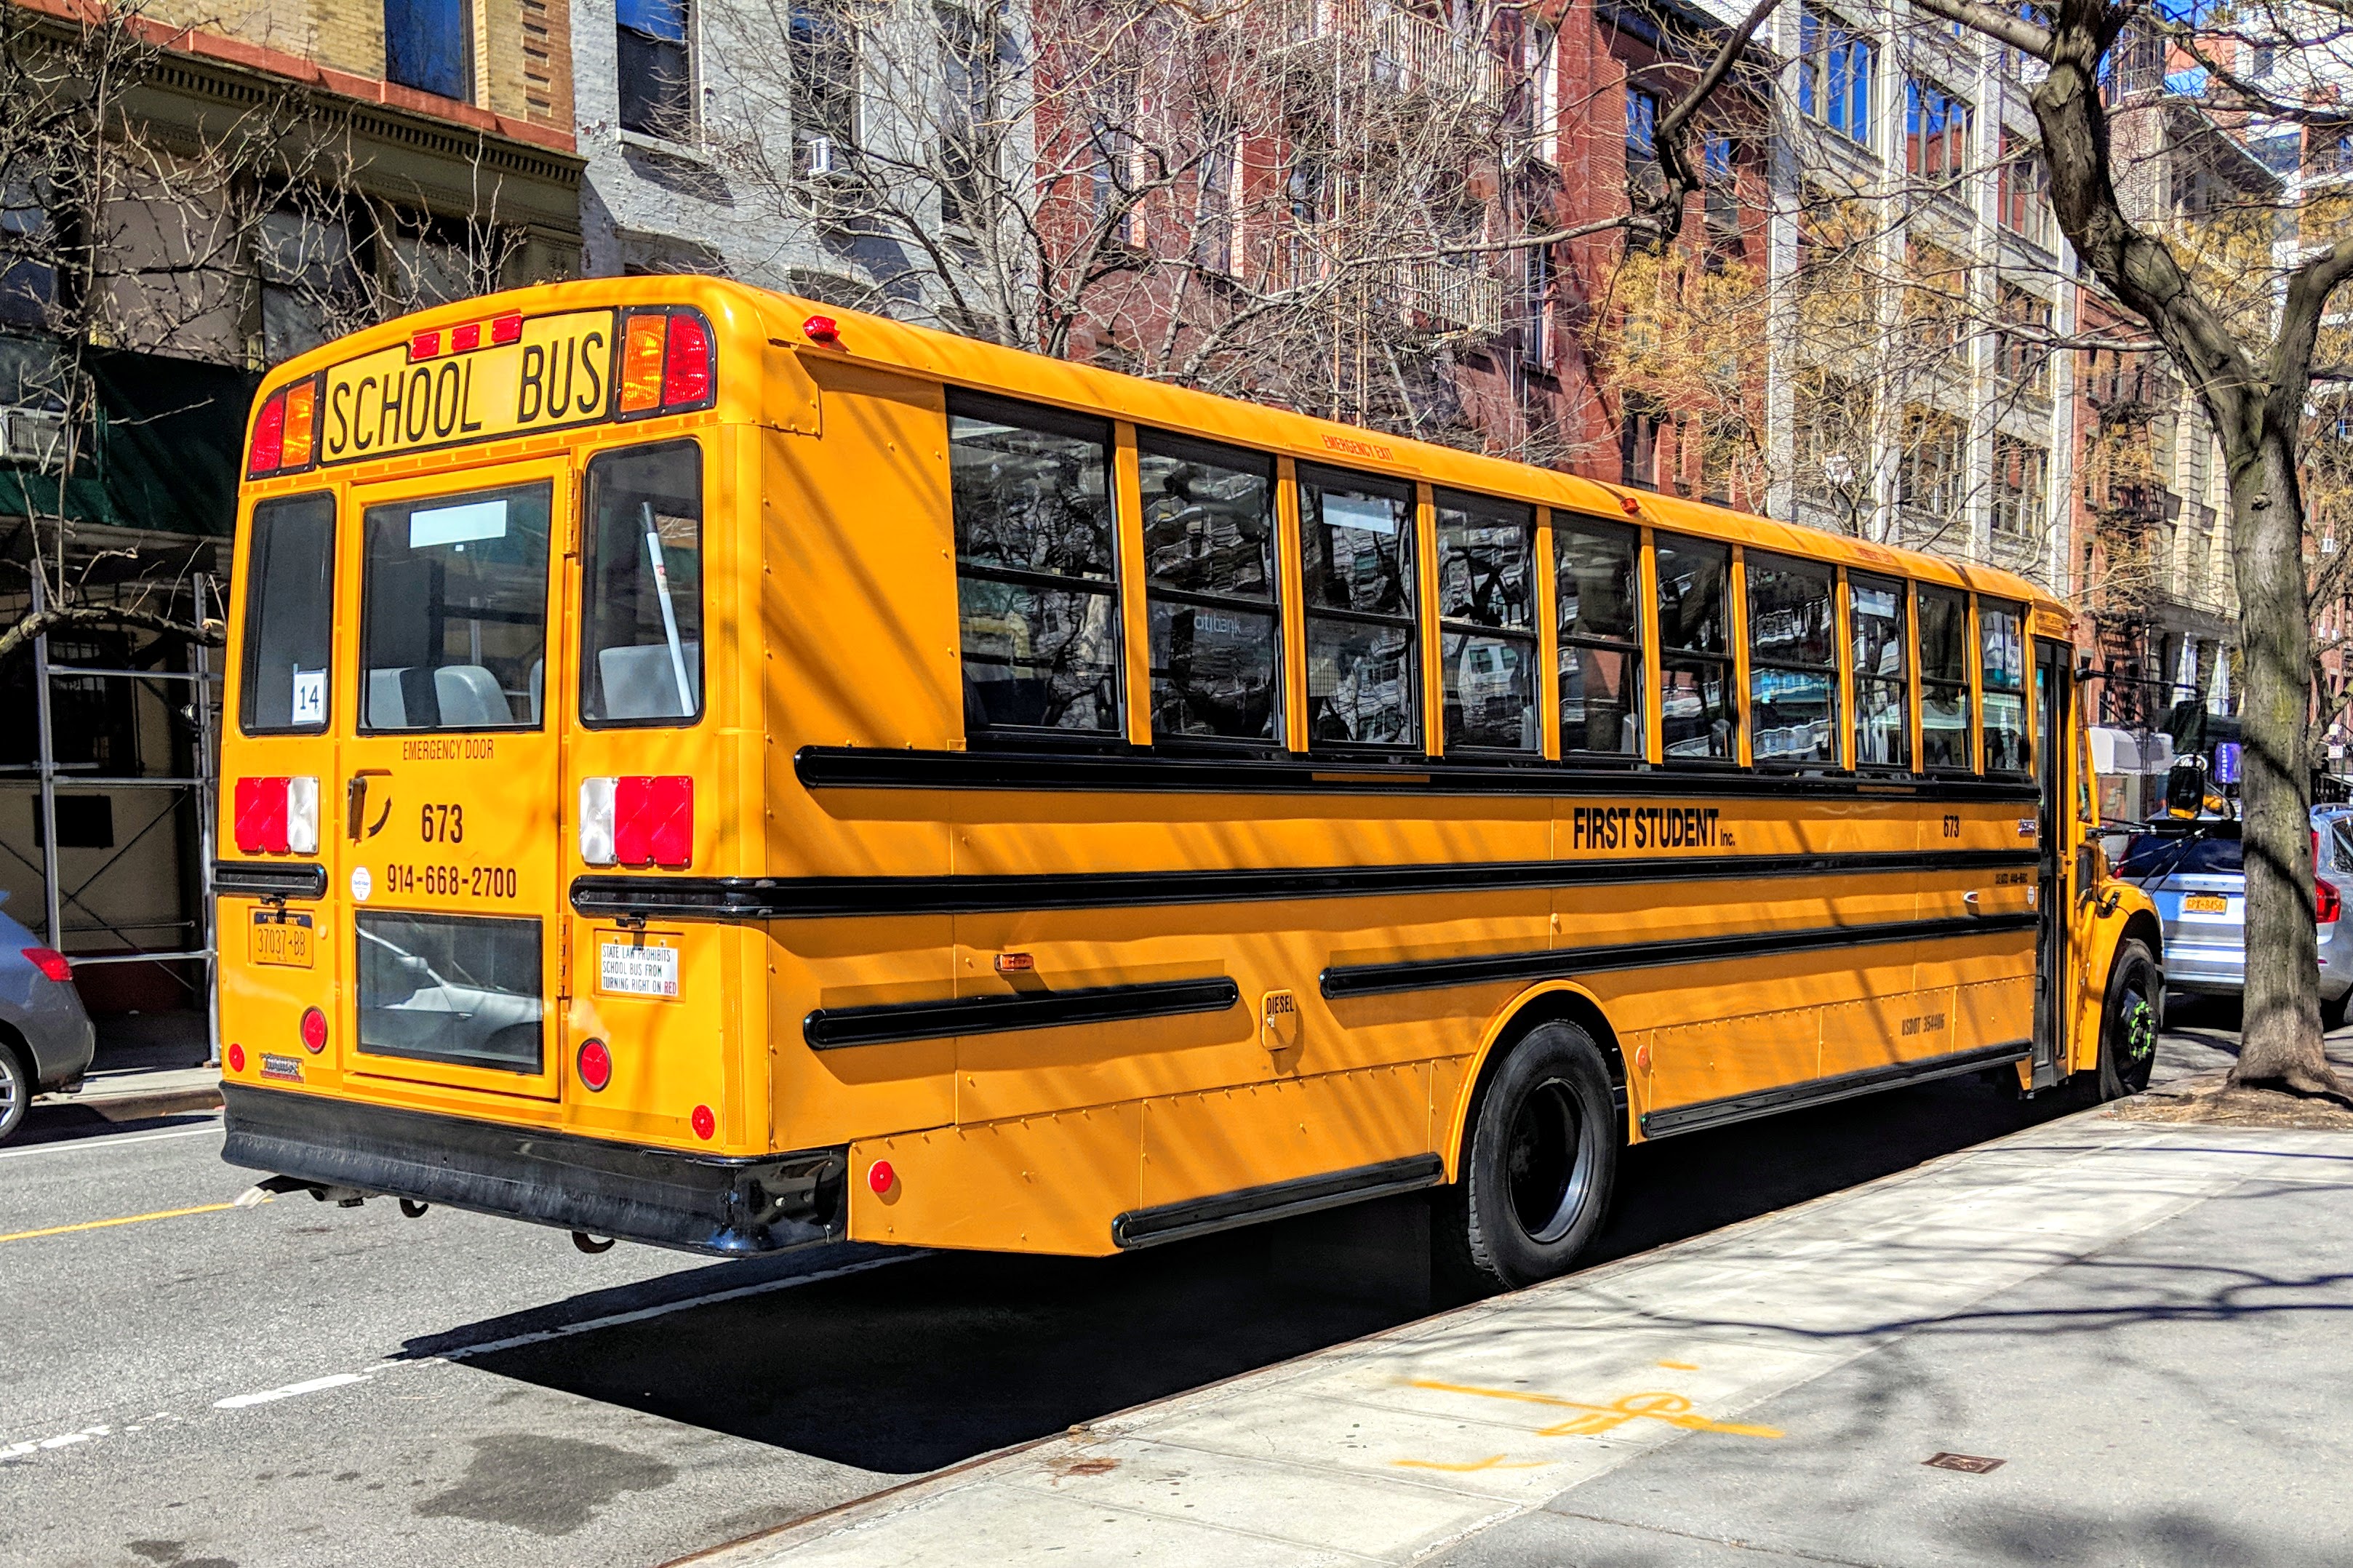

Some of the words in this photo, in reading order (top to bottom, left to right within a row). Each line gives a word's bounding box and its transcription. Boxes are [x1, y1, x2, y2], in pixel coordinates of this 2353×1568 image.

[329, 358, 483, 454] SCHOOL
[517, 332, 604, 425] BUS
[1321, 434, 1375, 457] EMERGENCY
[1373, 444, 1394, 461] EXIT
[300, 684, 319, 711] 14
[403, 740, 462, 761] EMERGENCY
[466, 739, 494, 759] DOOR
[421, 804, 463, 843] 673
[1574, 807, 1631, 849] FIRST
[1634, 807, 1719, 849] STUDENT
[1720, 828, 1735, 847] Inc.
[1943, 815, 1959, 838] 673
[387, 864, 516, 898] 914-668-2700
[603, 945, 619, 959] STATE
[623, 947, 634, 959] LAW
[639, 948, 671, 962] PROHIBITS
[603, 961, 627, 975] SCHOOL
[630, 963, 642, 976] BUS
[645, 964, 663, 977] FROM
[603, 976, 629, 990] TURNING
[632, 978, 650, 991] RIGHT
[652, 980, 661, 993] ON
[664, 981, 677, 994] RED
[1266, 995, 1294, 1015] DIESEL
